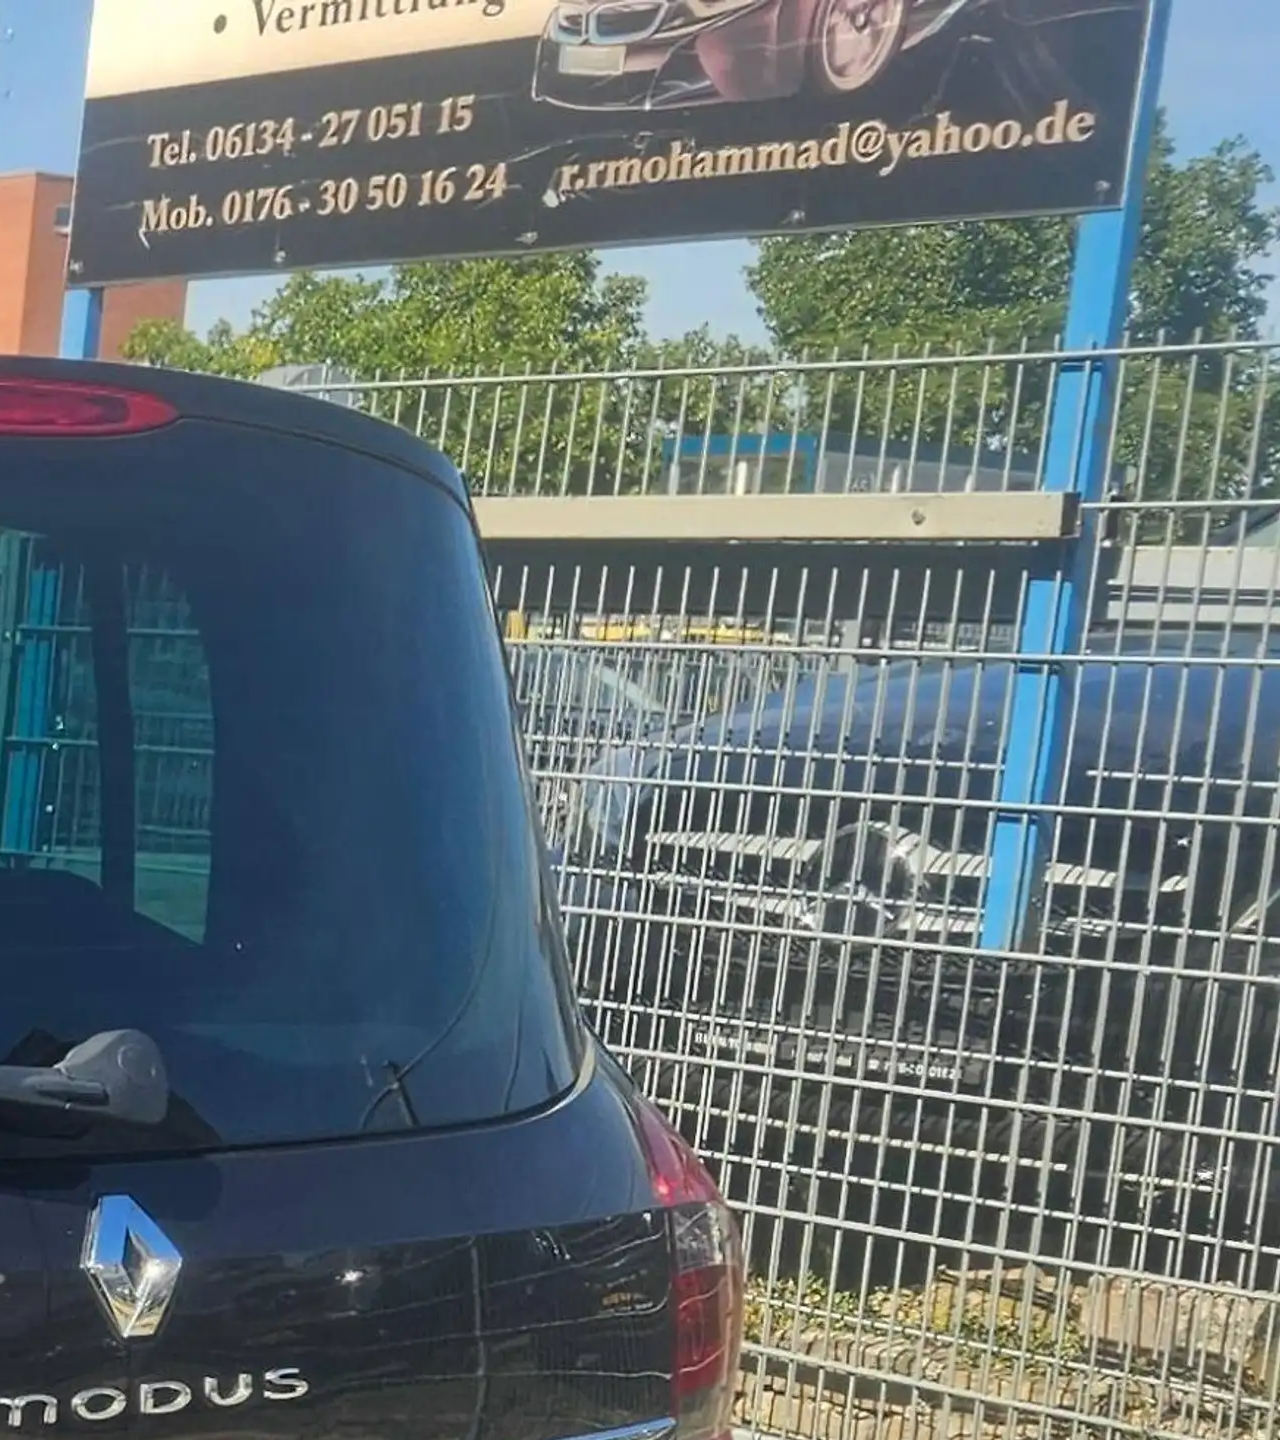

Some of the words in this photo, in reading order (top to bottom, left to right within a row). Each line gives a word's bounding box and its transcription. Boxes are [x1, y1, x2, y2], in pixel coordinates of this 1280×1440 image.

[148, 132, 197, 168] Tel.
[205, 117, 295, 160] 06134
[320, 109, 357, 148] 27
[367, 102, 421, 142] 051
[438, 95, 475, 133] 15
[558, 100, 1095, 192] r.rmohammad@yahoo.de
[142, 194, 213, 234] Mob.
[222, 185, 293, 226] 0176
[317, 177, 358, 216] 30
[367, 172, 407, 210] 50
[420, 166, 456, 205] 16
[464, 161, 507, 200] 24
